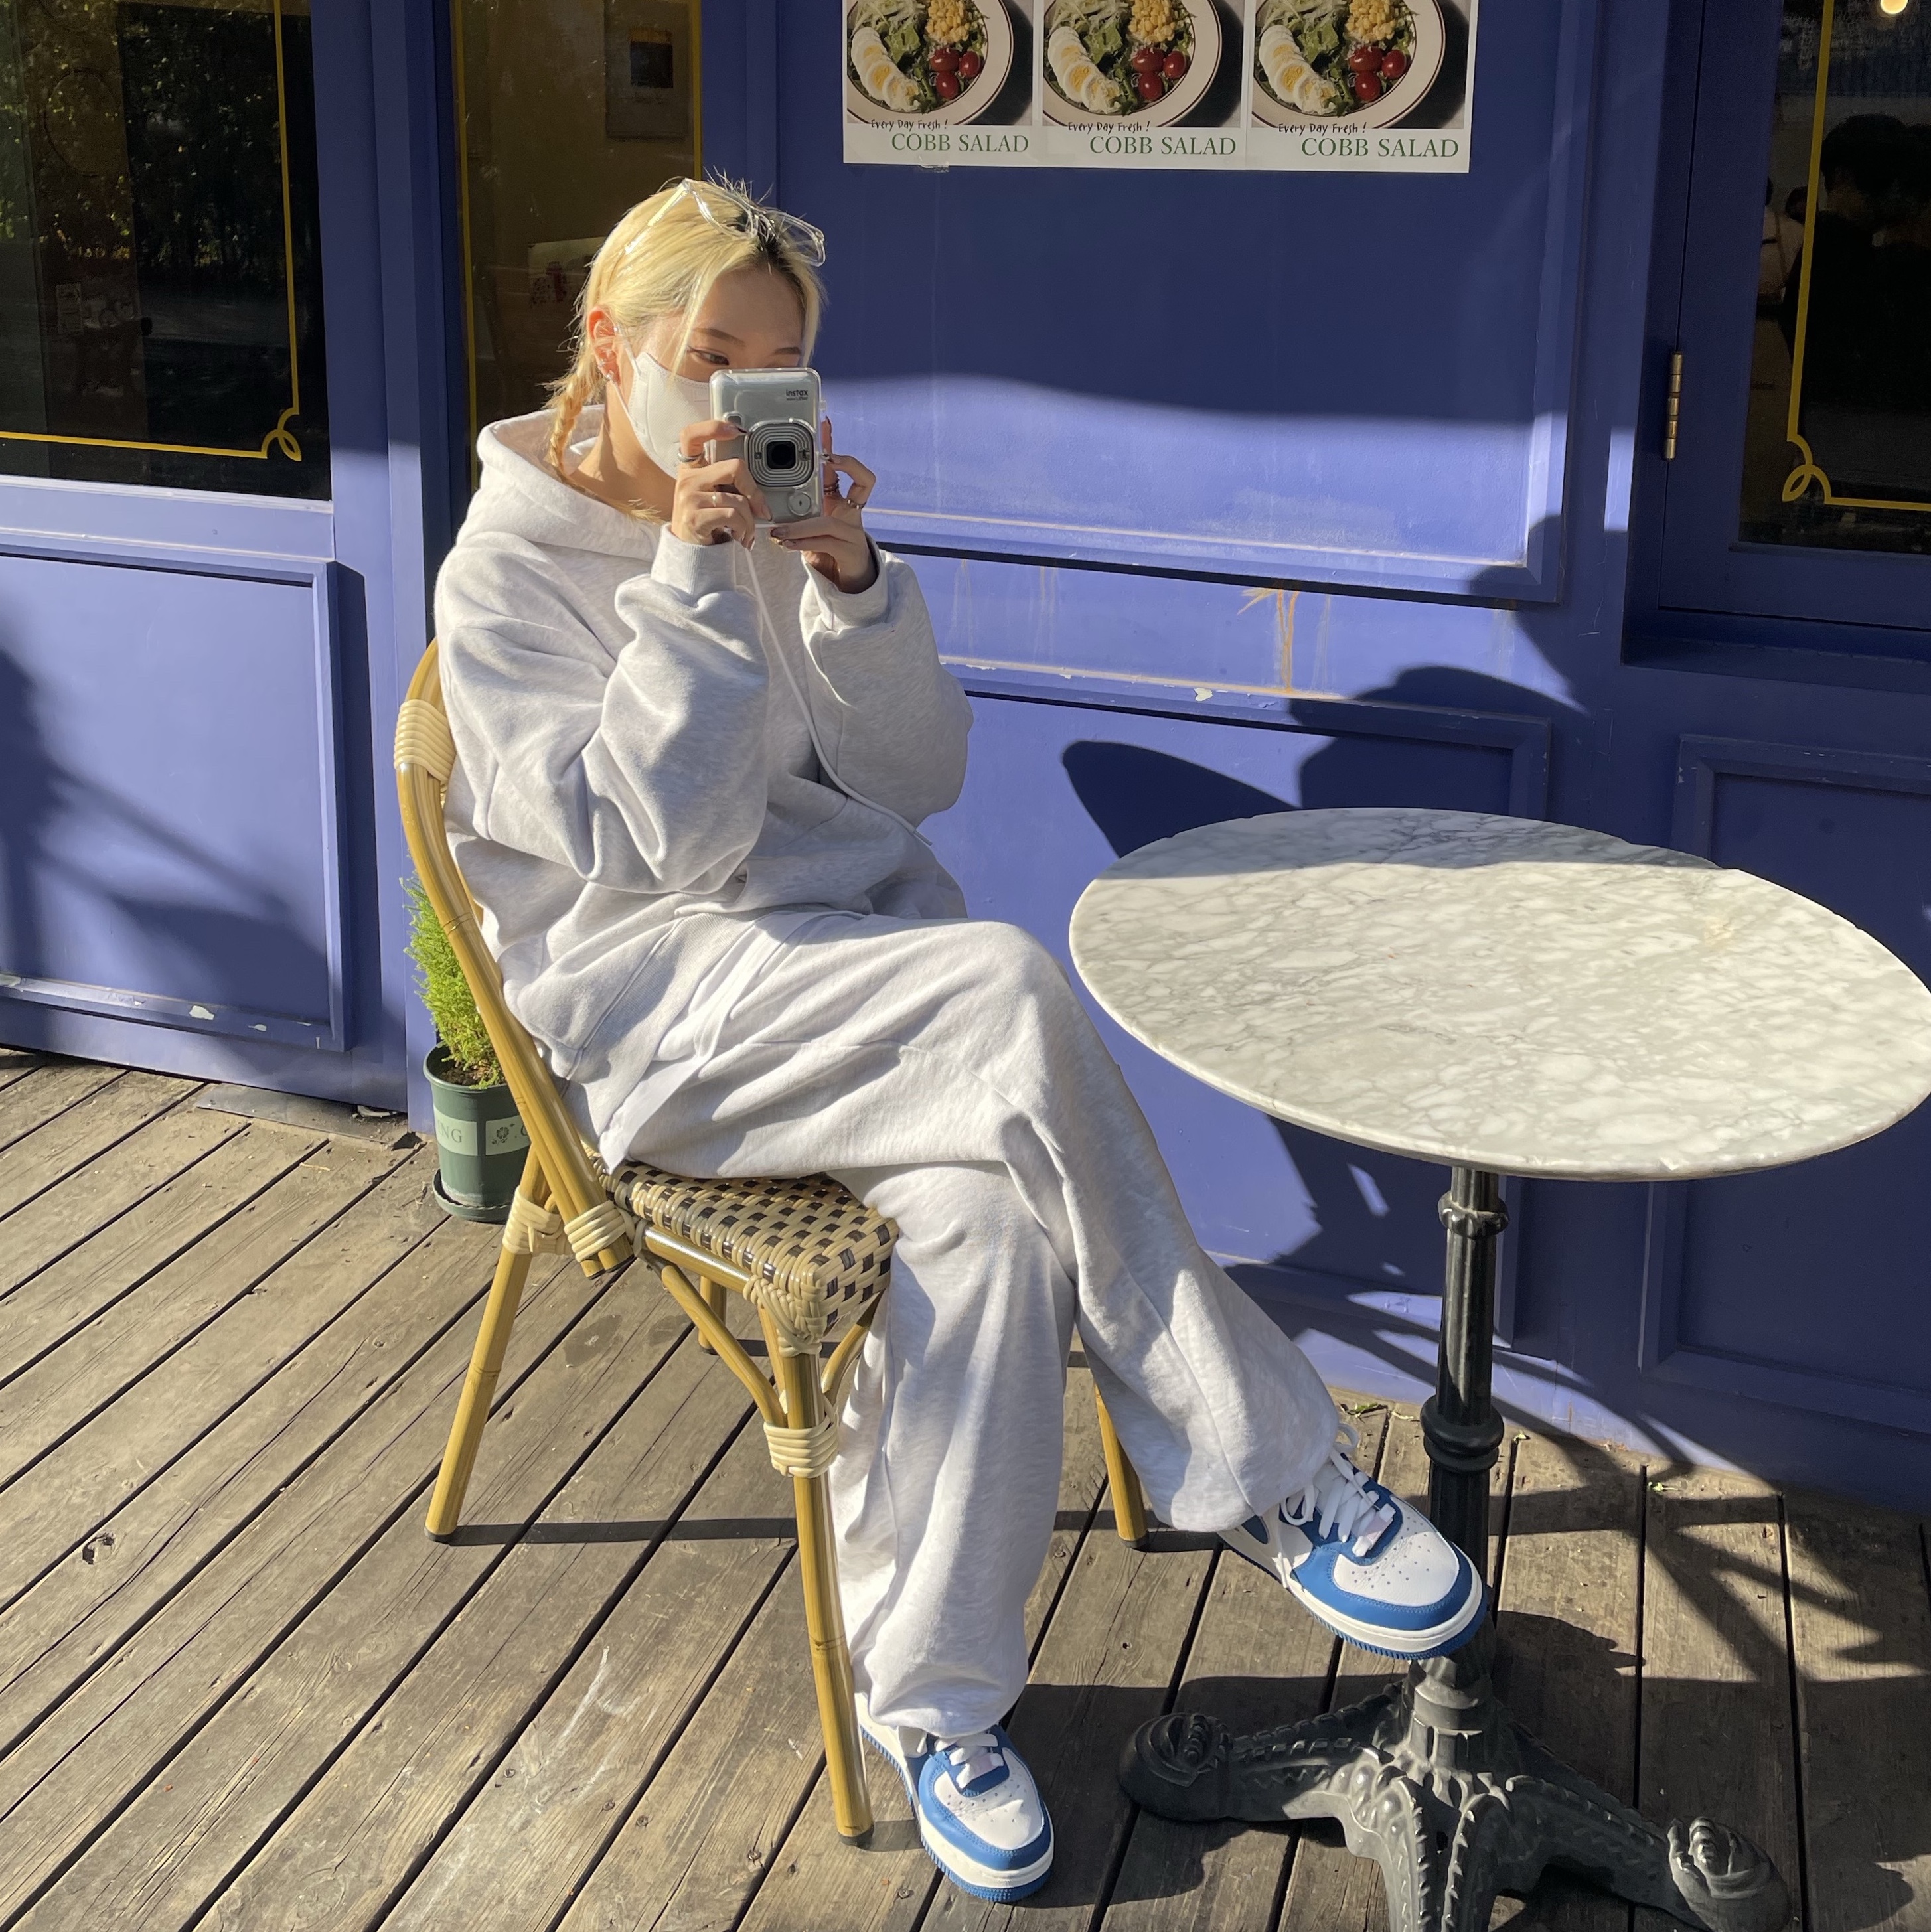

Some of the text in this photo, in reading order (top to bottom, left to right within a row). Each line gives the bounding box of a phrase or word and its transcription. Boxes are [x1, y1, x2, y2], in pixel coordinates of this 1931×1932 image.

[871, 119, 894, 132] Every
[897, 119, 914, 132] Day
[1068, 122, 1093, 135] Every
[1097, 122, 1114, 135] Day
[1278, 123, 1305, 137] Every
[1309, 123, 1328, 137] Day
[891, 133, 1029, 152] COBB SALAD
[1090, 136, 1236, 155] COBB SALAD
[1302, 137, 1458, 157] COBB SALAD
